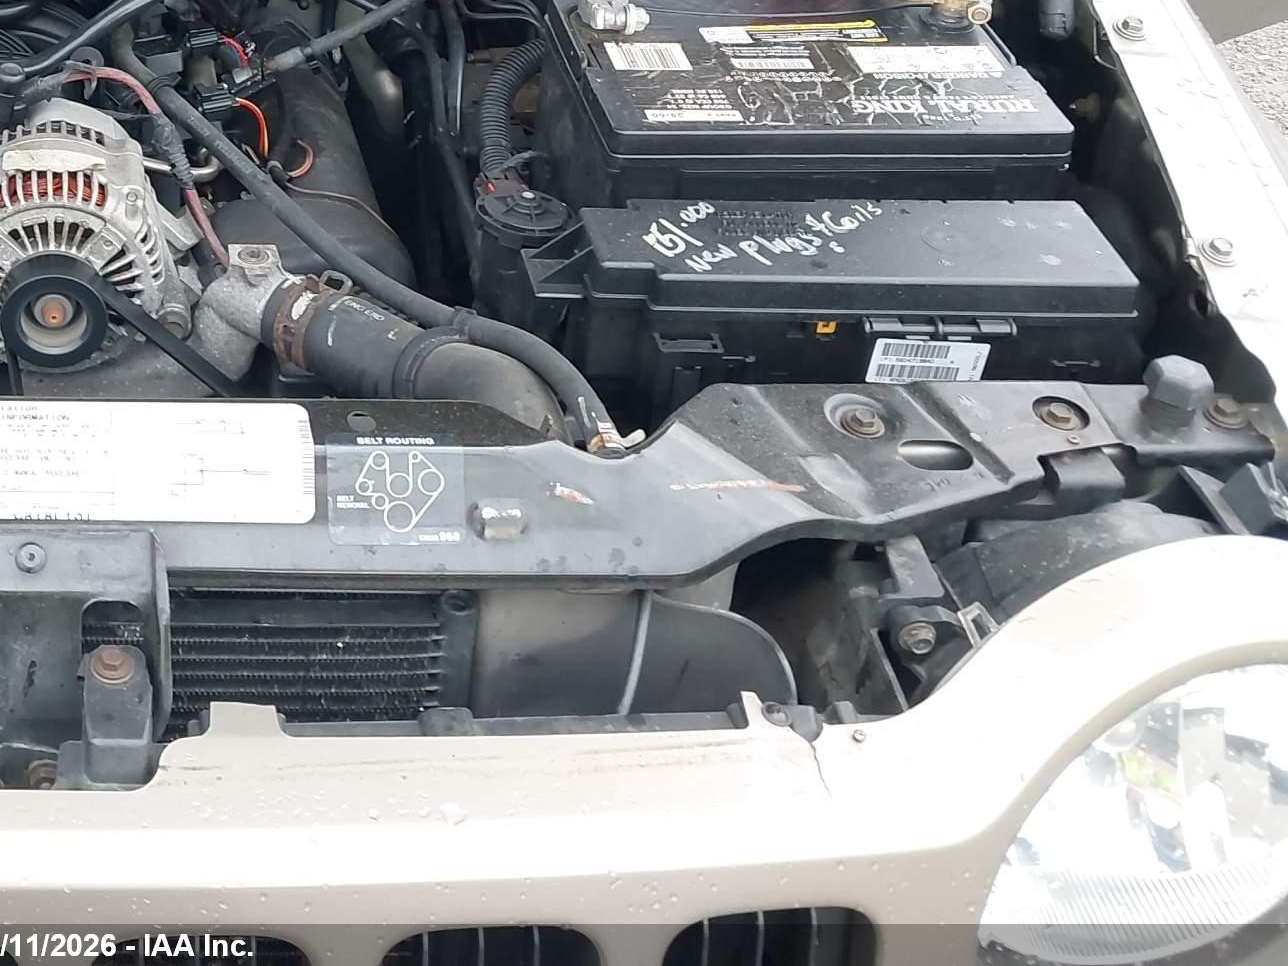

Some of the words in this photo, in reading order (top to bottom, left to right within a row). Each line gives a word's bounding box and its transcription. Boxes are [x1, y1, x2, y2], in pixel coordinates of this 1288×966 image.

[851, 99, 927, 114] KING
[928, 99, 1040, 114] RURAL
[1, 413, 70, 422] INFORMATION
[356, 436, 383, 445] BELT
[385, 436, 435, 446] ROUTING
